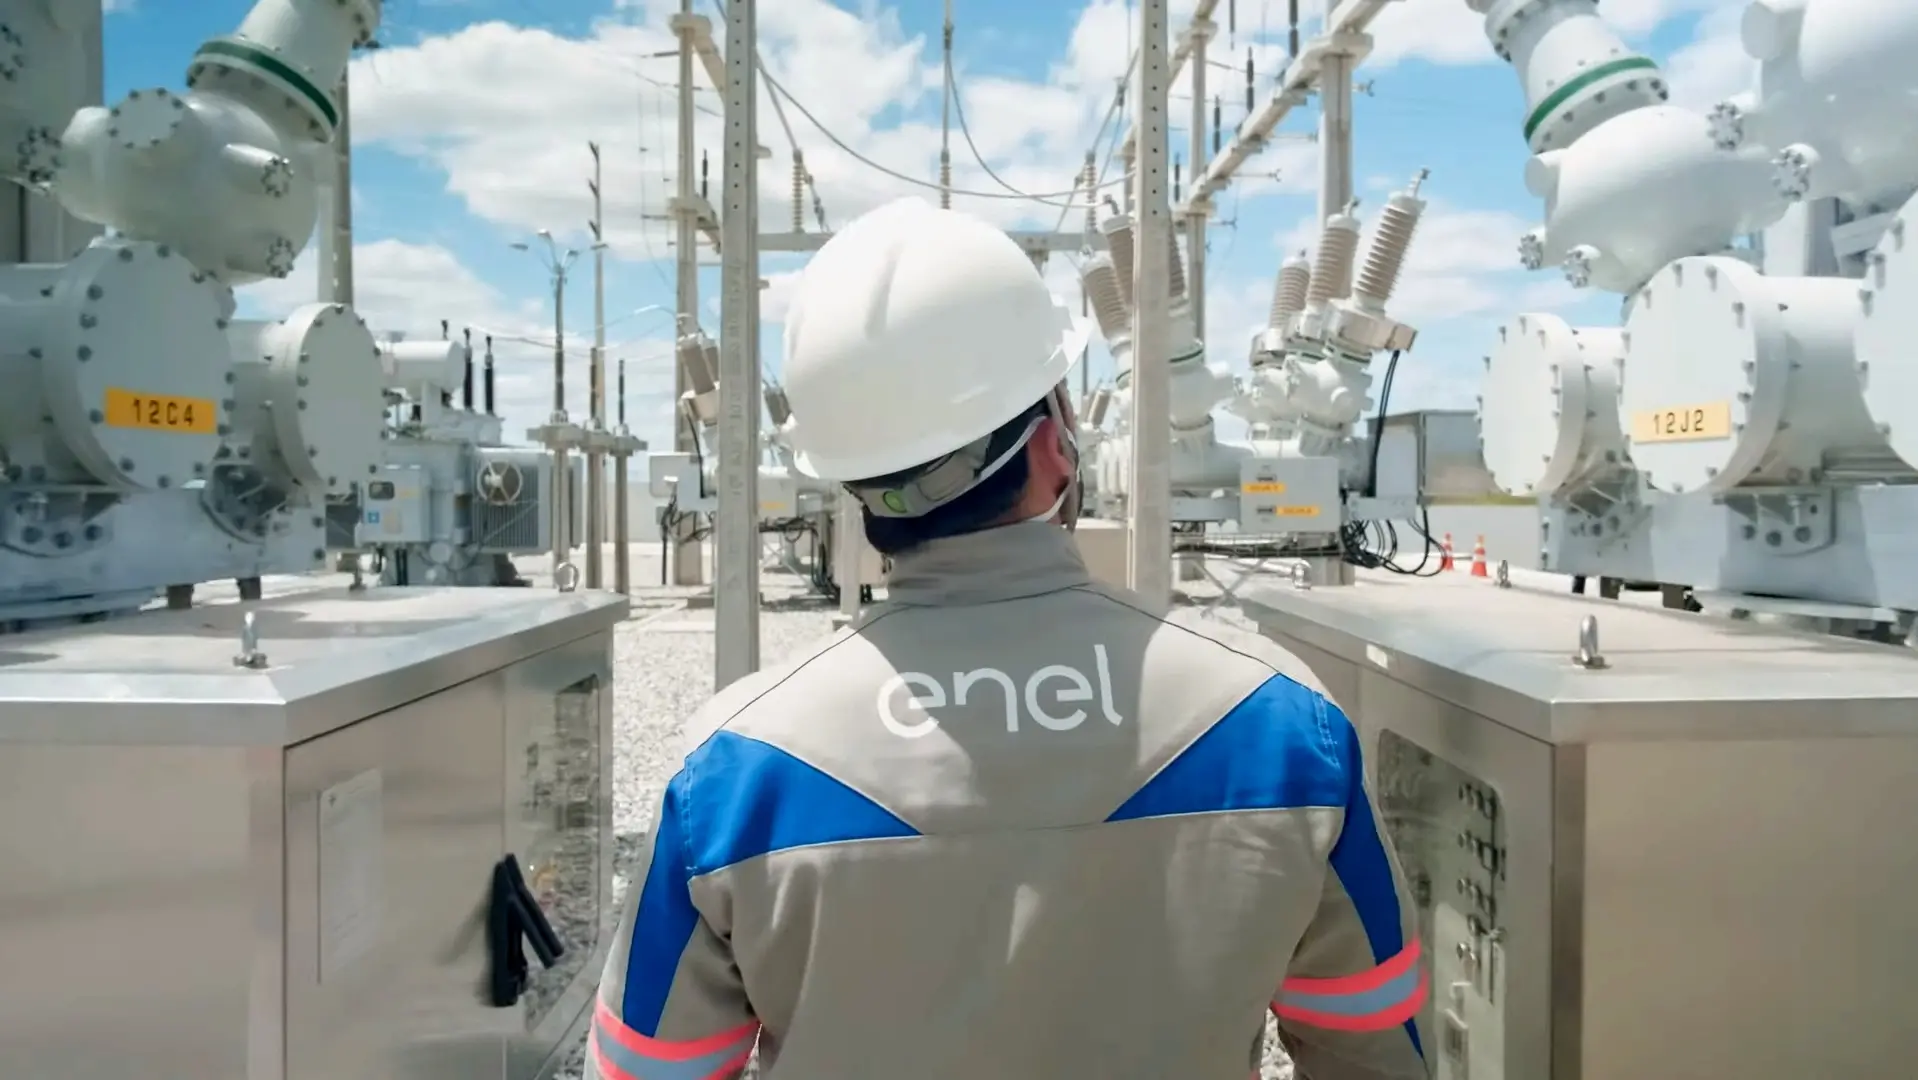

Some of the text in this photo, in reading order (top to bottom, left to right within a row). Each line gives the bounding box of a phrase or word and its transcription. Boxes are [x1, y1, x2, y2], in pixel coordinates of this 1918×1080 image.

[133, 399, 195, 426] 12C4
[1653, 409, 1704, 435] 12J2
[877, 644, 1123, 738] enel
